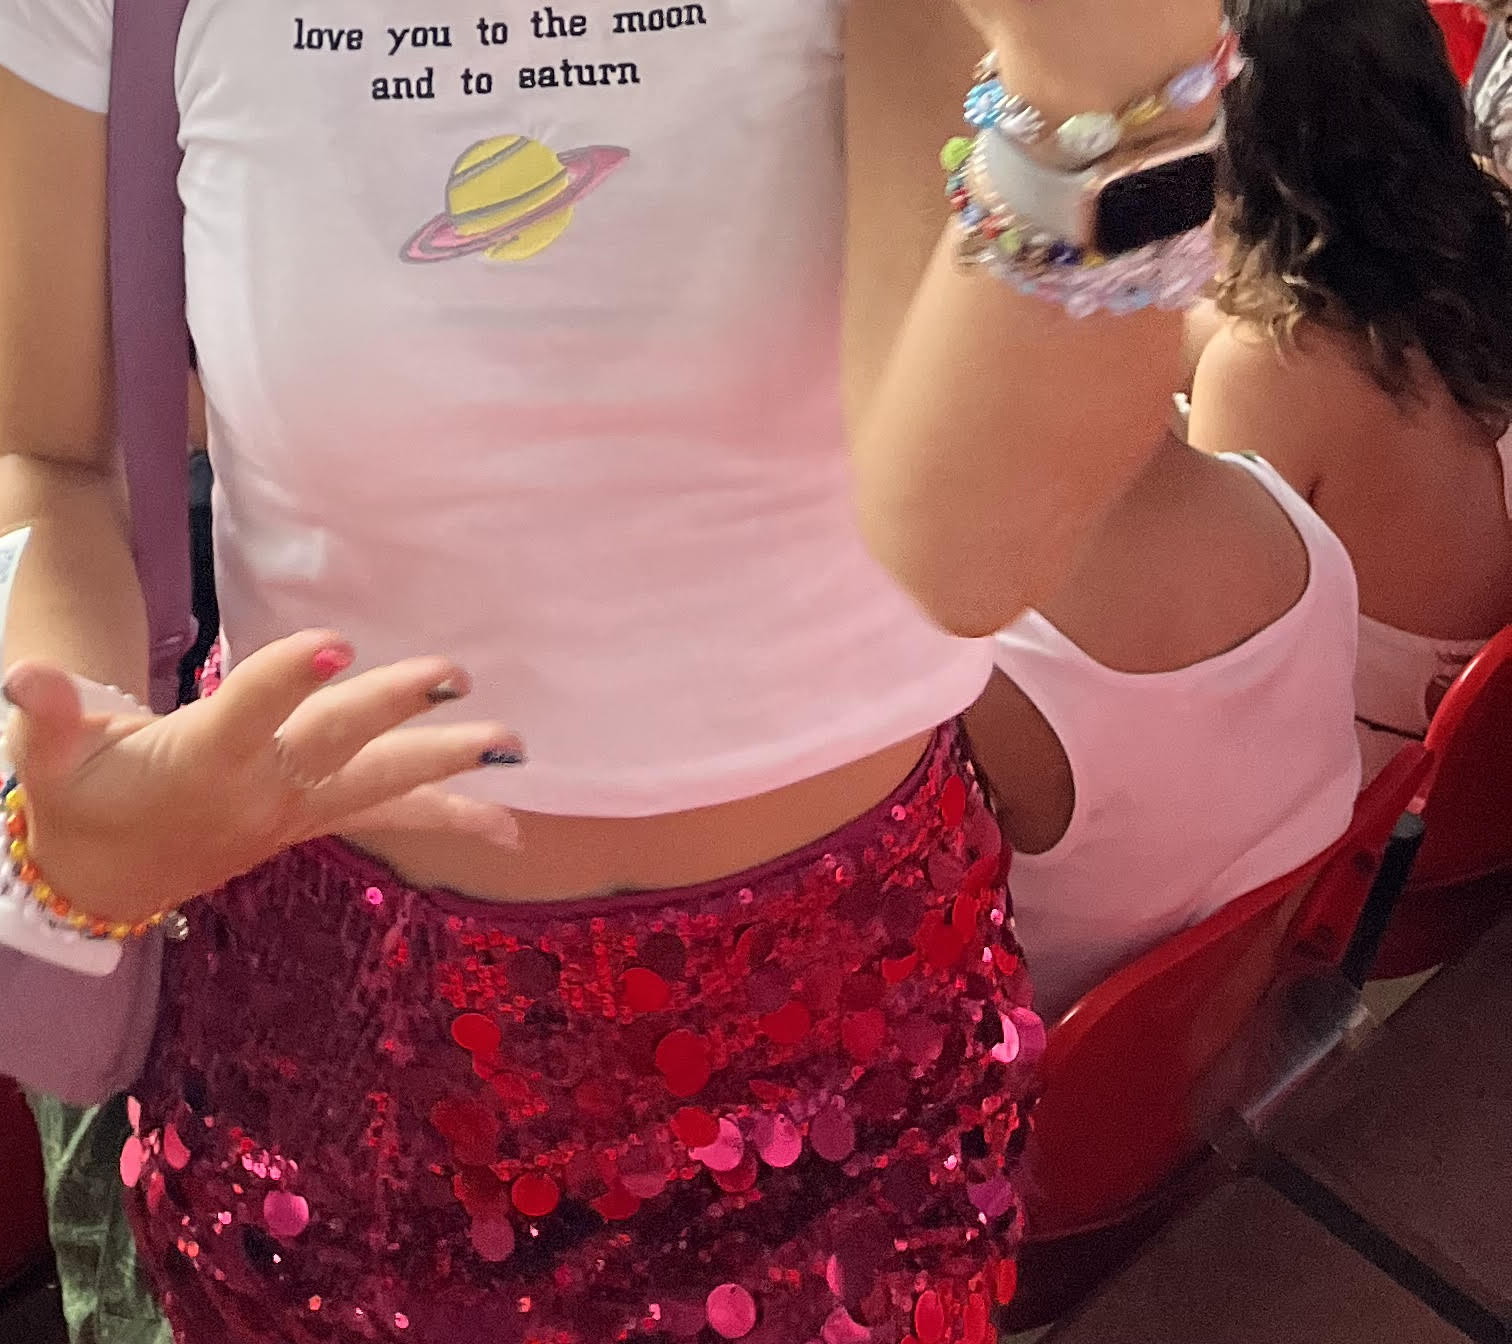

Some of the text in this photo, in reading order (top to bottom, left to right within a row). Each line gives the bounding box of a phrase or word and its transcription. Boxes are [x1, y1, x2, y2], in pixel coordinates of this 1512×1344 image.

[292, 2, 706, 55] love you to the moon
[371, 58, 641, 99] and to saturn
